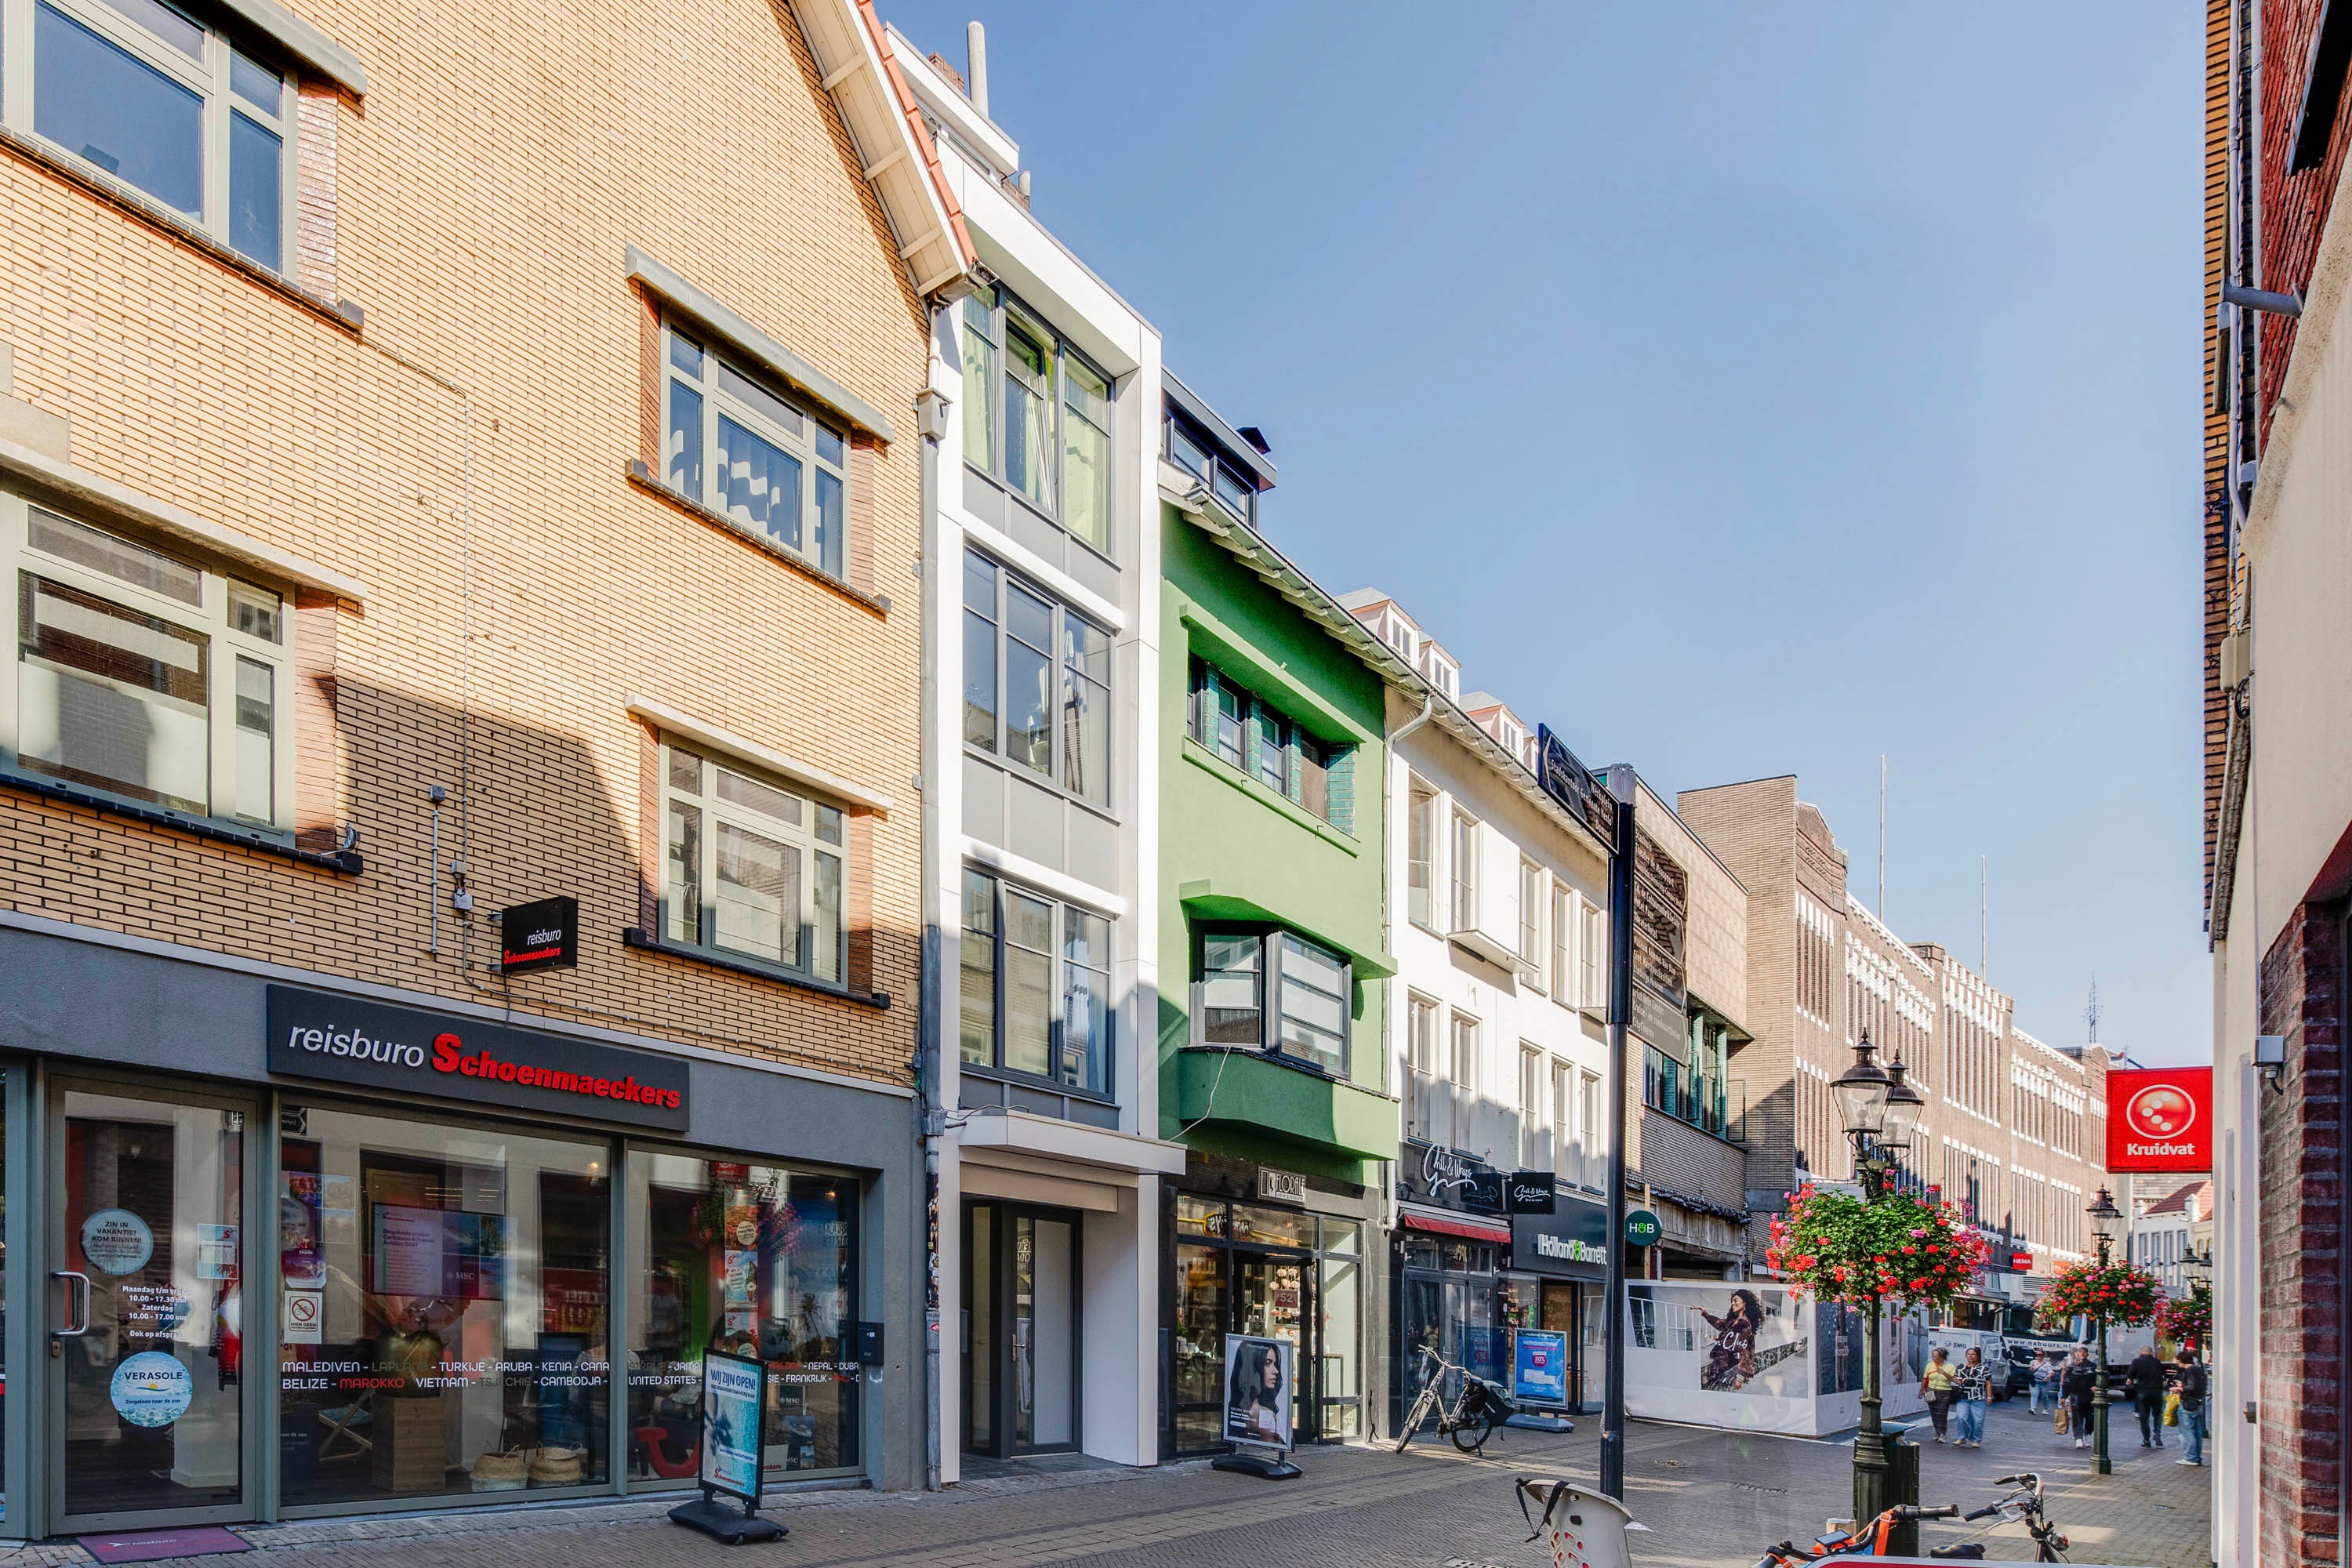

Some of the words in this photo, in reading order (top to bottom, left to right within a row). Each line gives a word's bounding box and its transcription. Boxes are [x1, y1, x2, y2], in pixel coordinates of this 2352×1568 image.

[1550, 759, 1580, 794] Stadskantoor
[1580, 788, 1601, 815] Gemeente
[1601, 809, 1613, 826] Venlo
[1590, 780, 1613, 811] Werkplein
[1635, 842, 1650, 864] Theater
[1656, 862, 1675, 887] Maaspoort
[527, 928, 561, 946] reisburo
[503, 946, 561, 964] Schoenmaeckers
[289, 1024, 424, 1068] reisburo
[432, 1033, 681, 1109] Schoenmaeckers
[2127, 1142, 2195, 1156] Kruidvat
[1447, 1156, 1453, 1176] &
[1454, 1159, 1473, 1185] Wraps
[1629, 1223, 1654, 1233] H&B
[455, 1272, 475, 1280] MSC
[122, 1286, 154, 1294] Maandag
[1279, 1293, 1293, 1302] 52
[1722, 1331, 1748, 1351] Club
[2007, 1339, 2071, 1349] www.nabuurs.nl
[282, 1362, 361, 1372] MALEDIVEN
[439, 1362, 486, 1372] TURKIJE
[495, 1362, 532, 1371] ARUBA
[542, 1362, 572, 1371] KENIA
[580, 1362, 610, 1371] CANA
[674, 1362, 702, 1371] JAMAI
[808, 1362, 833, 1370] NEPAL
[839, 1362, 859, 1370] DUBA
[282, 1378, 328, 1389] BELIZE
[339, 1377, 405, 1388] MAROKKO
[416, 1377, 469, 1388] VIETNAM
[540, 1376, 601, 1386] CAMBODJA
[629, 1376, 662, 1385] UNITED
[663, 1375, 697, 1385] STATES
[768, 1374, 779, 1383] SIE
[786, 1374, 827, 1383] FRANKRIJK
[710, 1369, 721, 1385] WIJ
[722, 1372, 735, 1387] ZIJN
[736, 1375, 756, 1390] OPEN!
